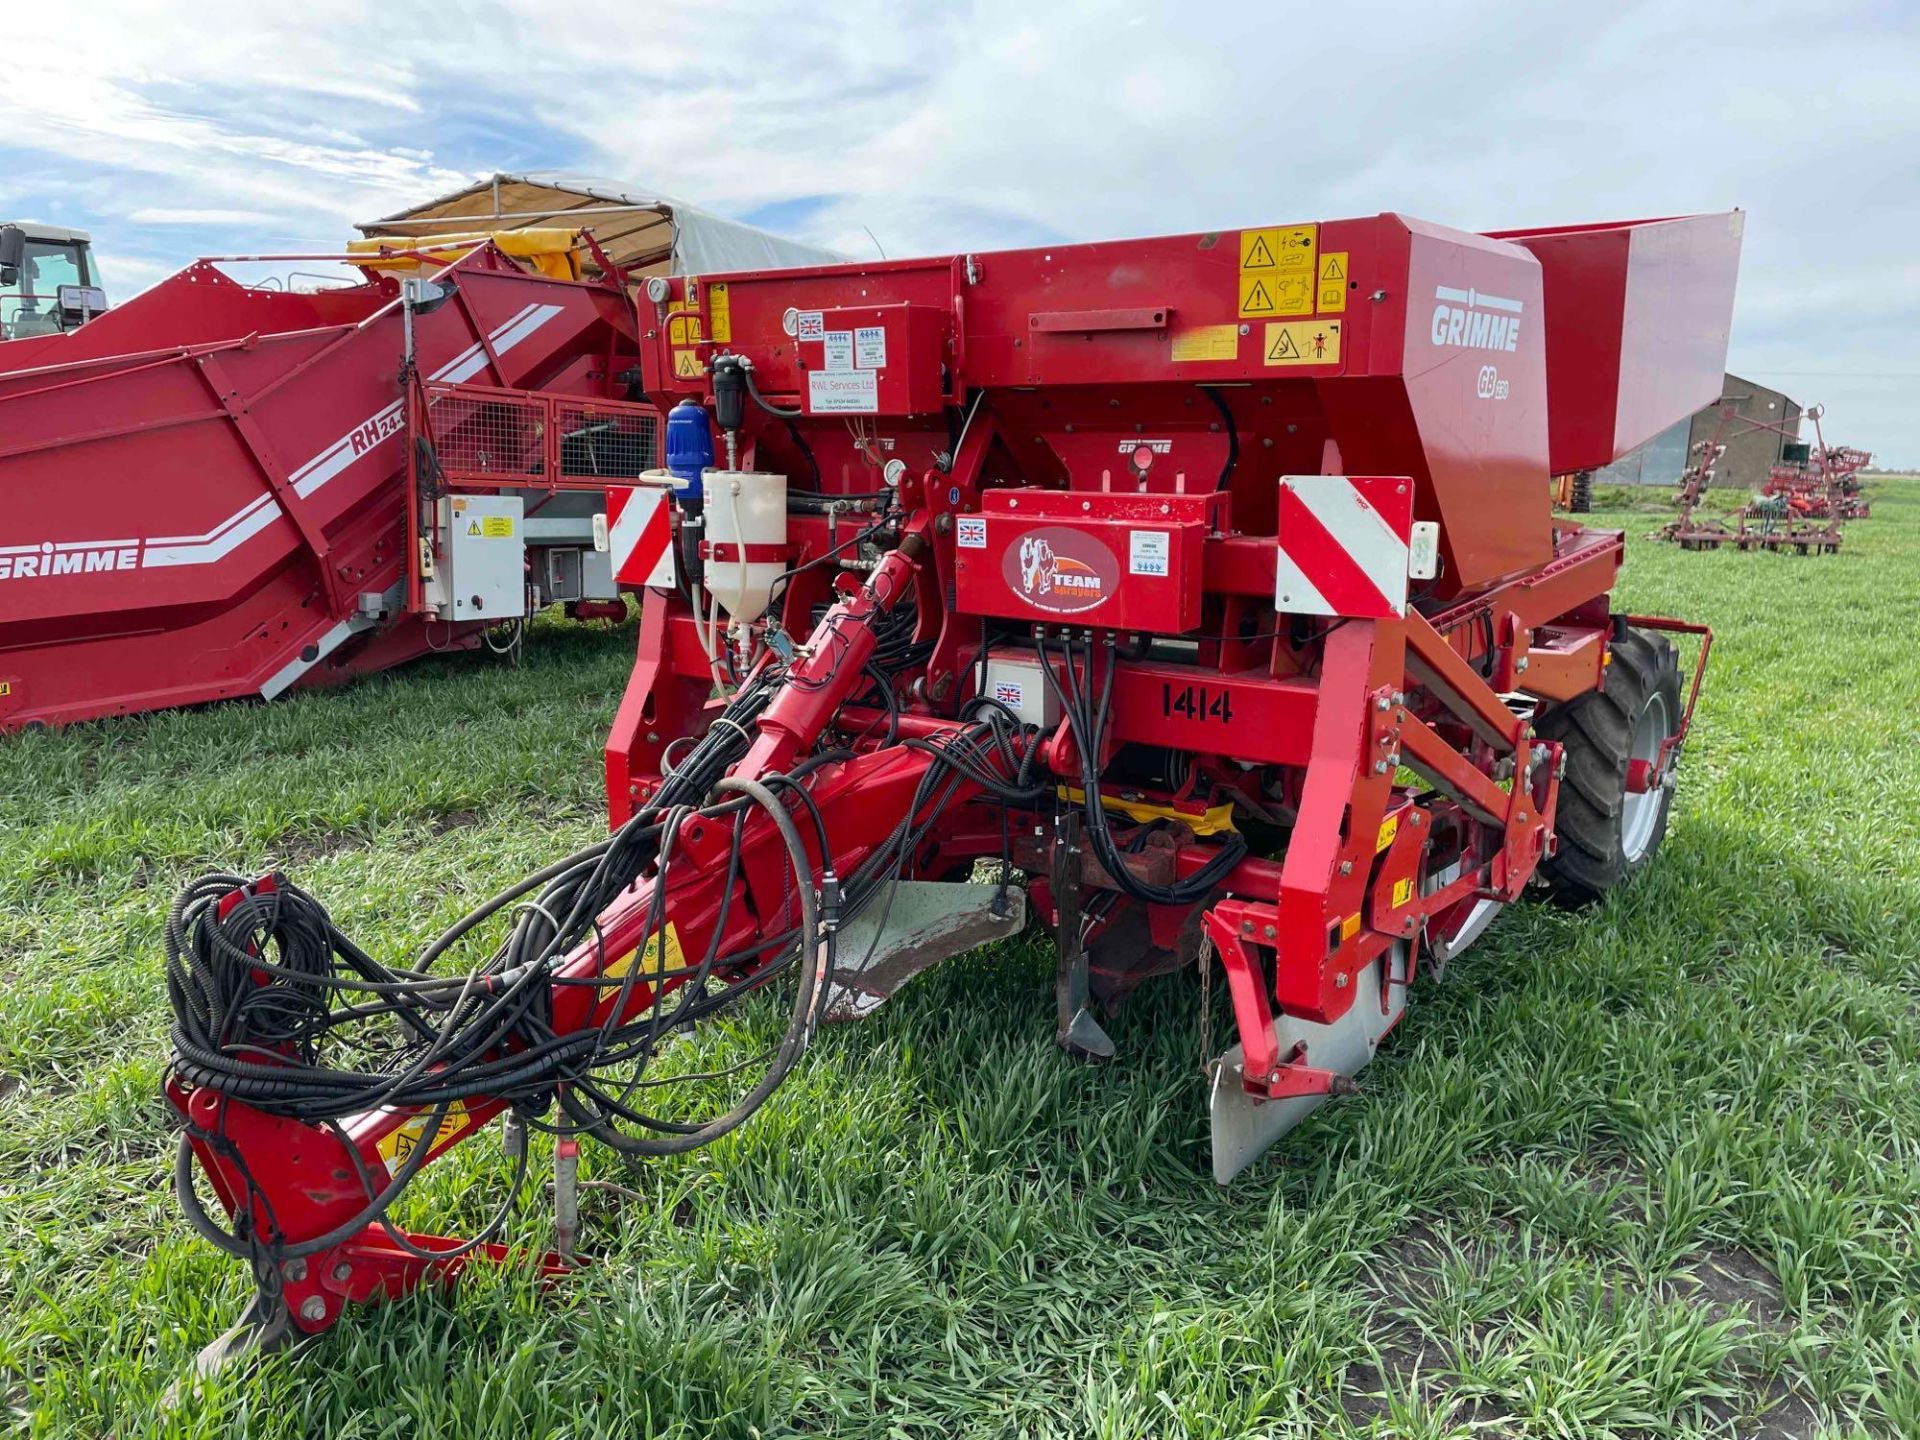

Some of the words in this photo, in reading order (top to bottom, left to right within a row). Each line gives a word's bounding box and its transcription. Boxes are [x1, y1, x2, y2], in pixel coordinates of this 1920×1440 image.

[1431, 288, 1521, 352] GRIMME
[830, 380, 860, 390] Services
[862, 379, 874, 390] Ltd
[1478, 366, 1497, 398] GB
[350, 419, 380, 456] RH
[1118, 439, 1172, 453] GRME
[1052, 574, 1101, 589] TEAM
[1053, 586, 1102, 598] sprayers
[1163, 683, 1233, 724] 1414
